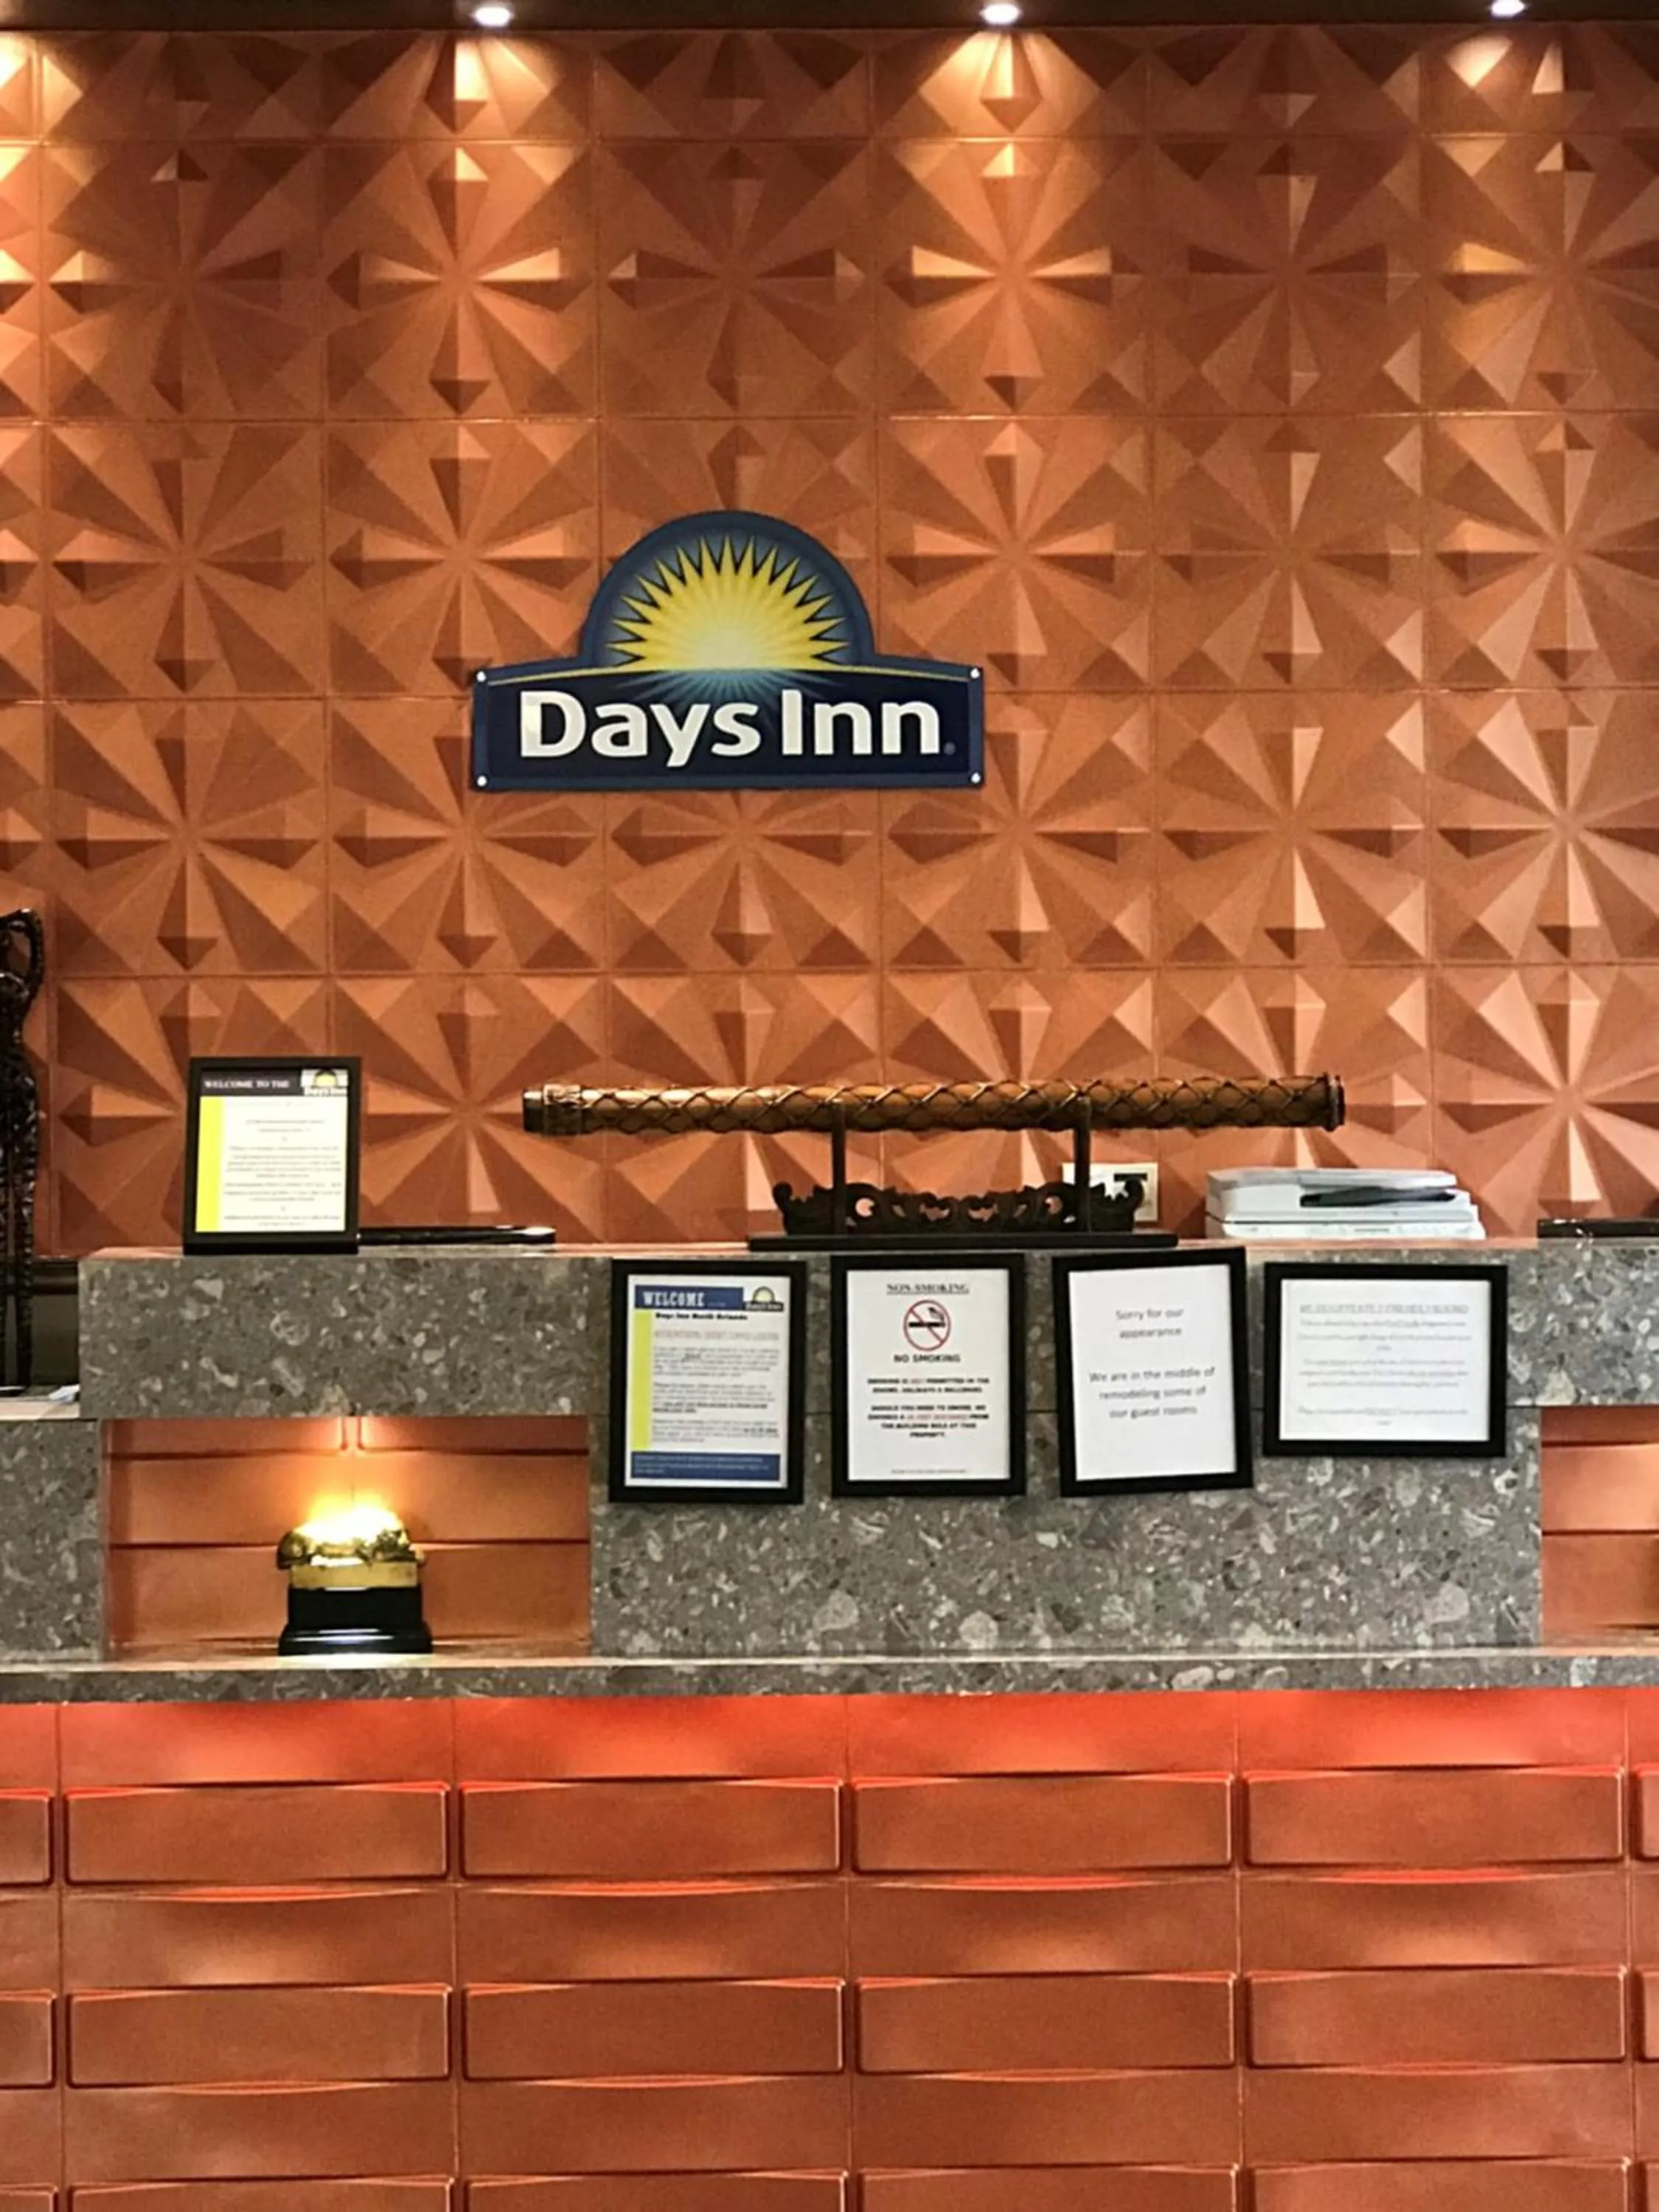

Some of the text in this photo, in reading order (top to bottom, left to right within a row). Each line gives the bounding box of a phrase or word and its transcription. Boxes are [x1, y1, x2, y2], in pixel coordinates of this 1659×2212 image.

[519, 689, 940, 767] Days Inn
[204, 1079, 291, 1088] WELCOME TO THE
[643, 1291, 705, 1307] WELCOME
[1115, 1309, 1184, 1321] Sorry for our
[1119, 1328, 1182, 1339] appearance
[894, 1354, 961, 1363] NO SMOKING
[1089, 1366, 1215, 1382] We are in the middle of
[1099, 1385, 1206, 1400] remodeling some of
[1109, 1406, 1197, 1420] our guest rooms
